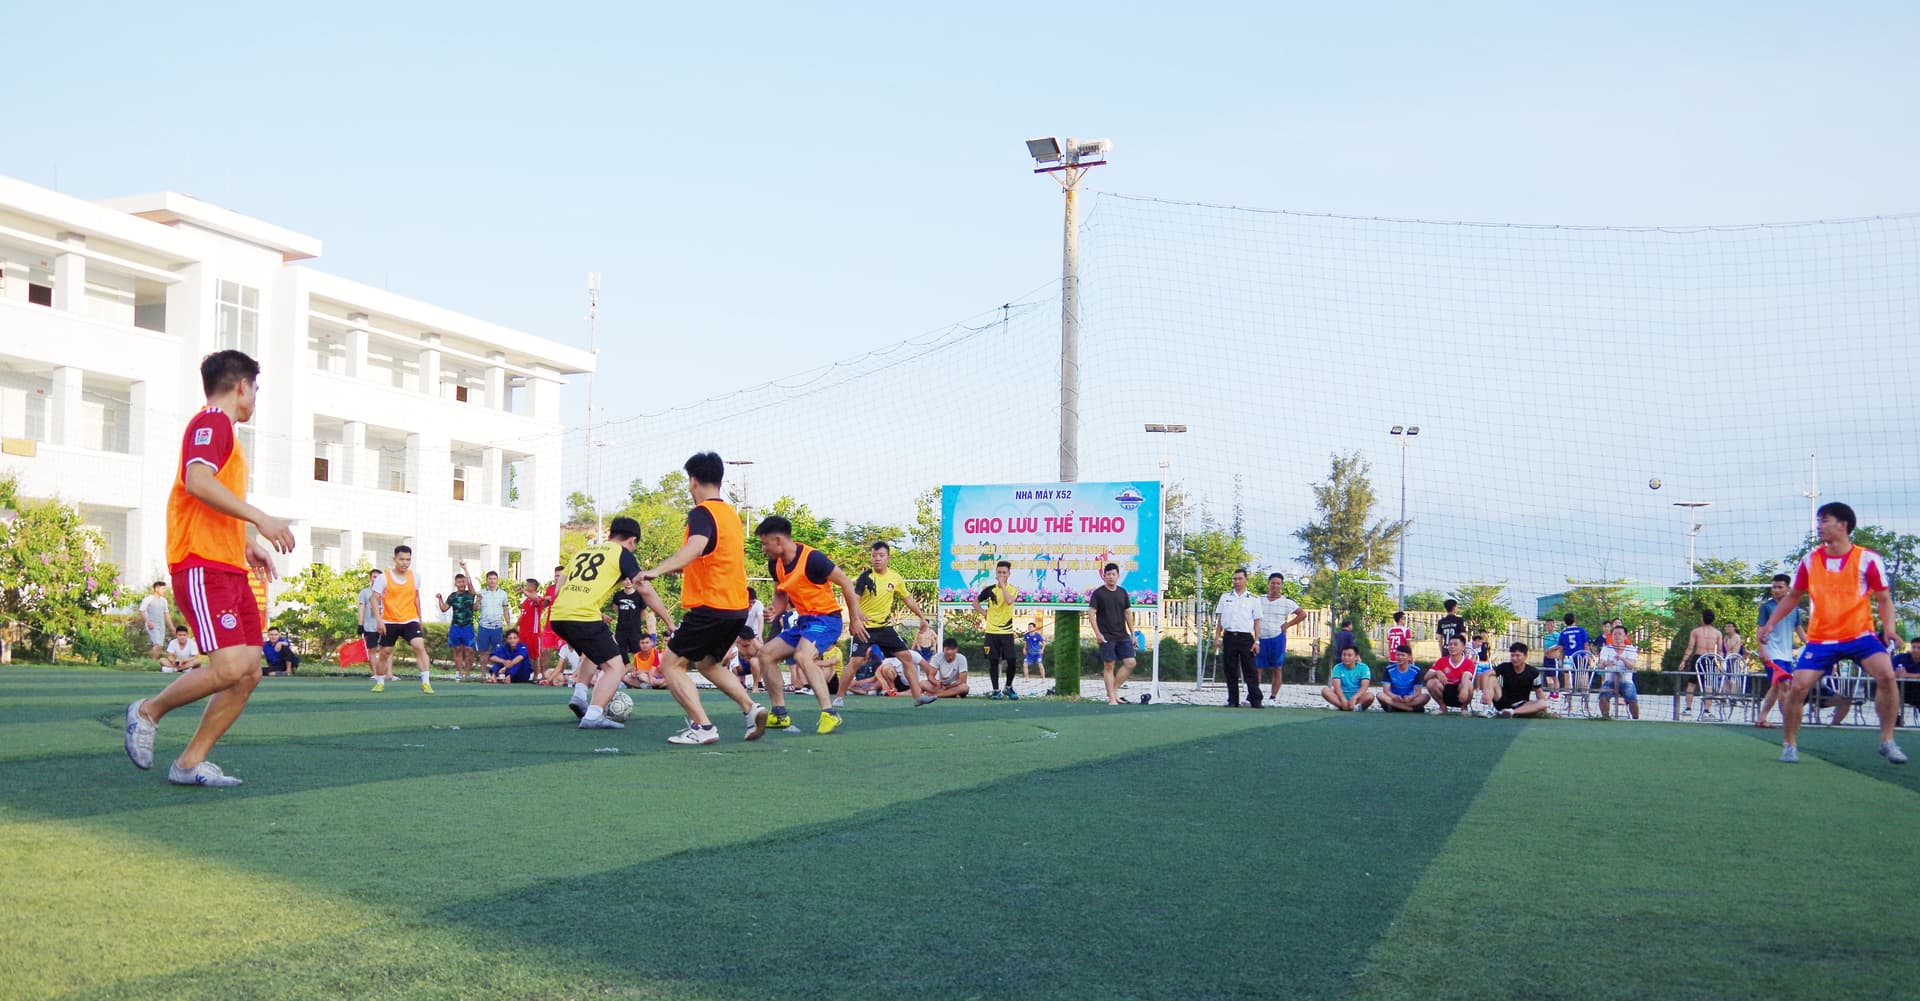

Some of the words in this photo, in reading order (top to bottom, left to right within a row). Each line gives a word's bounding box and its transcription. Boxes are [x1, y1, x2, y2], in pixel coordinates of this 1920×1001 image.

[1055, 489, 1072, 500] X52
[964, 517, 1003, 534] GIAO
[1007, 516, 1039, 534] LƯU
[1044, 510, 1075, 533] THỂ
[1079, 516, 1126, 534] THAO
[568, 552, 605, 582] 38
[1568, 634, 1577, 649] 5
